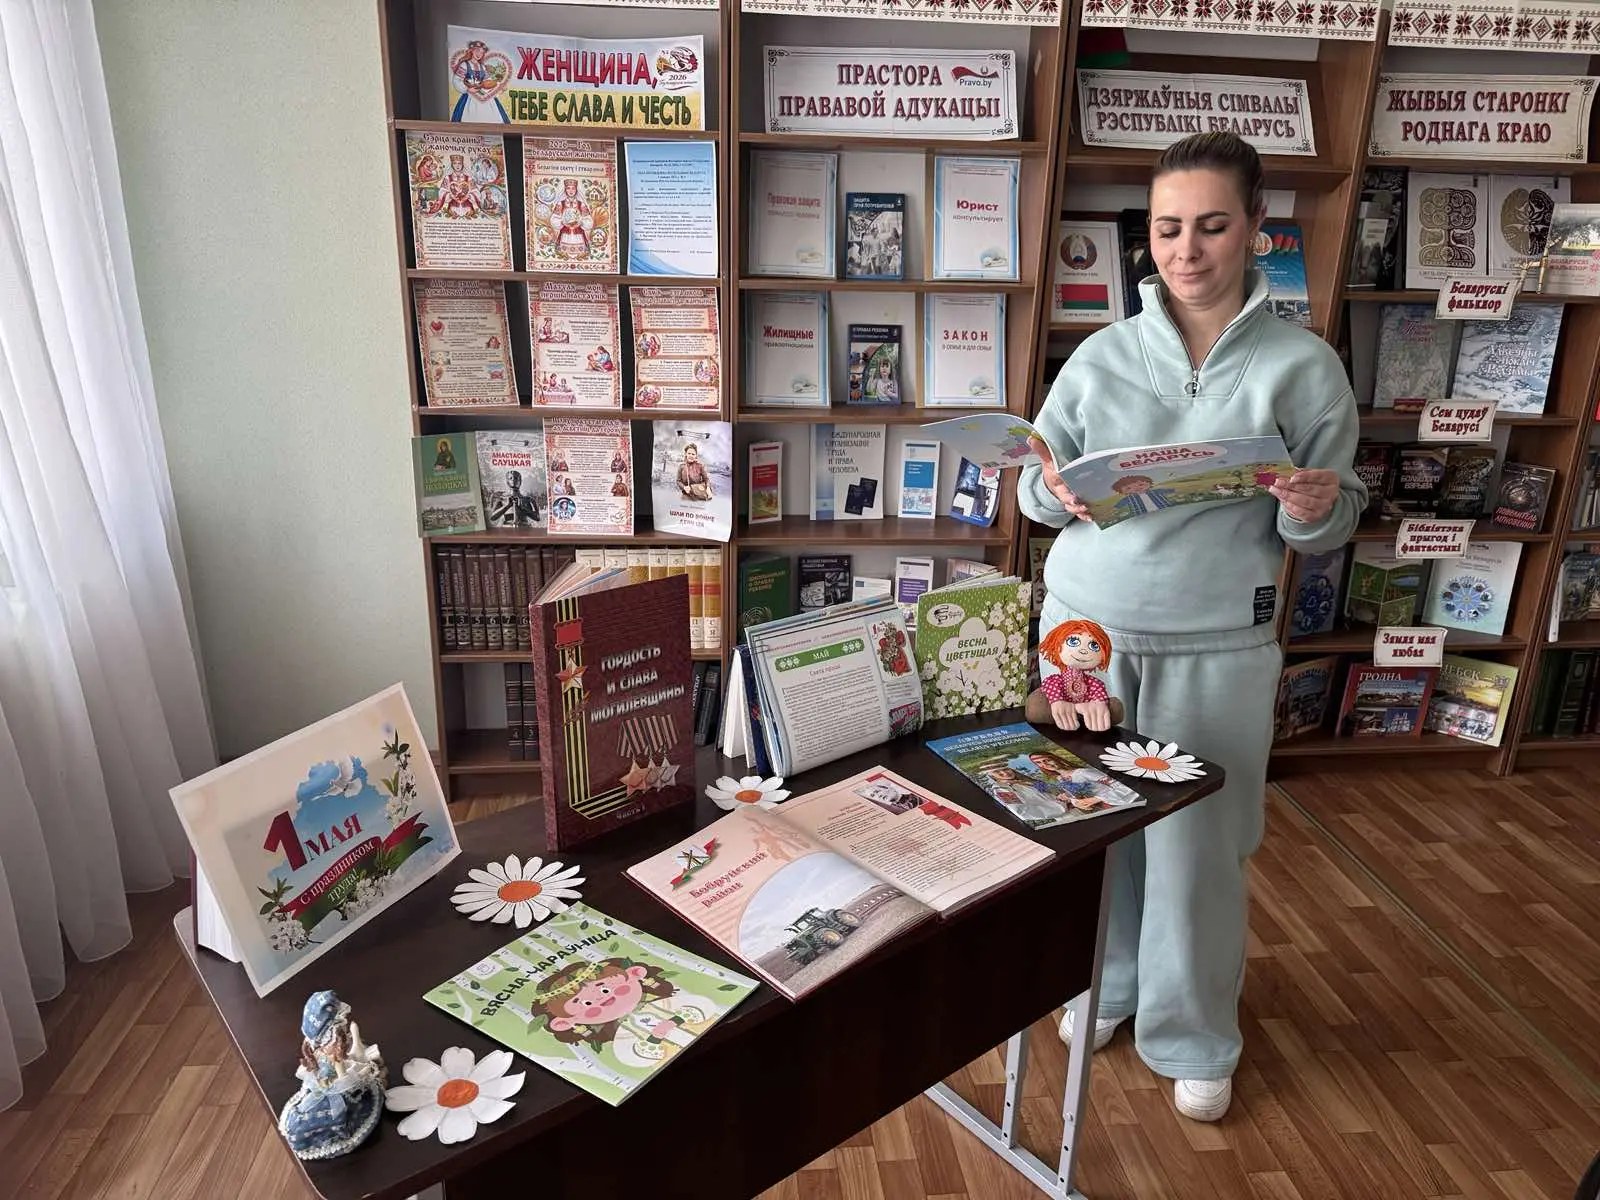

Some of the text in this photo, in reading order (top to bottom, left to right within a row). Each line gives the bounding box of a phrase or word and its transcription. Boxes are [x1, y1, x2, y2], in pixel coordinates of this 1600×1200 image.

[517, 46, 658, 89] ЖЕНЩИНА,
[837, 63, 943, 87] ПРАСТОРА
[959, 78, 993, 88] Pravo.by
[509, 90, 691, 125] ТЕБЕ СЛАВА И ЧЕСТЬ
[778, 90, 1001, 122] ПРАВАВОЙ АДУКАЦЫІ
[1087, 84, 1300, 115] ДЗЯРЖАЎНЫЯ СІМВАЛЫ
[1386, 90, 1571, 113] ЖЫВЫЯ СТАРОНКІ
[1096, 111, 1296, 138] РЭСПУБЛІКІ БЕЛАРУСЬ
[1401, 121, 1552, 145] РОДНАГА КРАЮ
[956, 199, 999, 213] Юрист
[952, 214, 1004, 223] консультирует
[1449, 281, 1510, 298] Беларускі
[1447, 295, 1502, 312] фальклор
[763, 325, 814, 340] Жилищные
[943, 329, 989, 341] ЗАКОН
[1429, 405, 1489, 421] Сем цудаў
[1431, 420, 1480, 435] Беларусі
[492, 452, 531, 460] АНАСТАСИЯ
[1119, 449, 1216, 469] БЕЛАРУСЬ
[1135, 447, 1192, 460] НАША
[492, 459, 532, 468] СЛУЦКАЯ
[1360, 472, 1385, 480] ОМУТ
[1407, 523, 1465, 533] Бібліятэка
[1409, 533, 1456, 544] прыгод і
[1400, 542, 1462, 554] фантастыкі
[957, 636, 988, 649] ВЕСНА
[1383, 633, 1436, 645] Зямля мая
[601, 646, 662, 672] ГОРДОСТЬ
[812, 649, 830, 659] МАЙ
[945, 646, 999, 662] ЦВЕТУЩАЯ
[1391, 646, 1425, 658] любая
[606, 670, 658, 695] И СЛАВА
[1358, 671, 1402, 682] ГРОДНА
[591, 684, 685, 723] МОГИЛЕВЩИНЫ
[263, 810, 363, 872] 1 МАЯ
[309, 841, 376, 898] праздником
[688, 849, 768, 899] Бобруйский
[327, 868, 361, 903] труда!
[701, 882, 744, 908] район
[480, 928, 618, 1018] ВЯСНА-ЧАРАЎНІЦА
